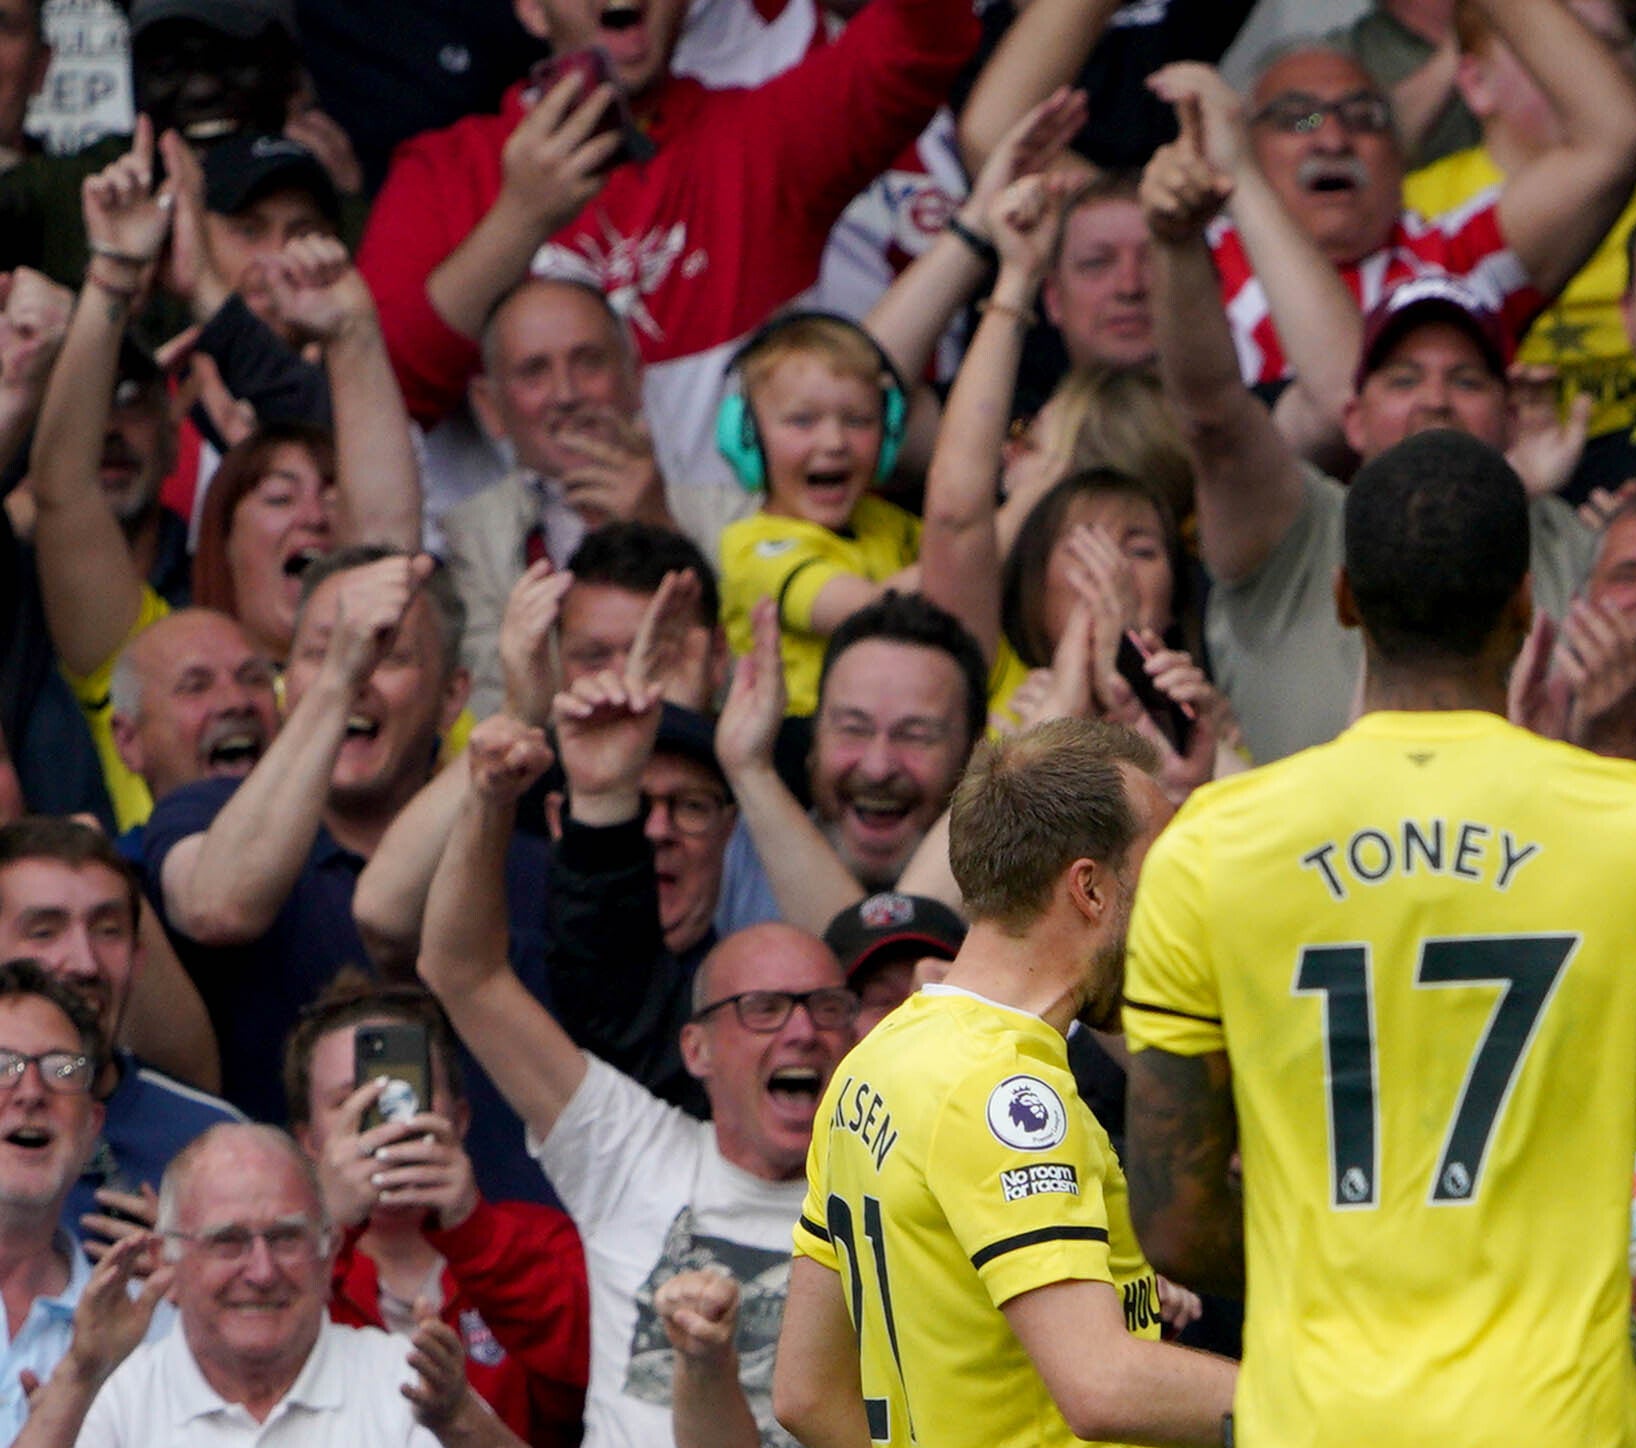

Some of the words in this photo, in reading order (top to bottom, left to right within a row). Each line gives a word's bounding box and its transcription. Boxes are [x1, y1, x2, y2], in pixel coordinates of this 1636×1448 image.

[1299, 819, 1541, 899] TONEY
[1291, 928, 1585, 1210] 17
[1000, 1169, 1029, 1187] No
[1029, 1165, 1074, 1182] room
